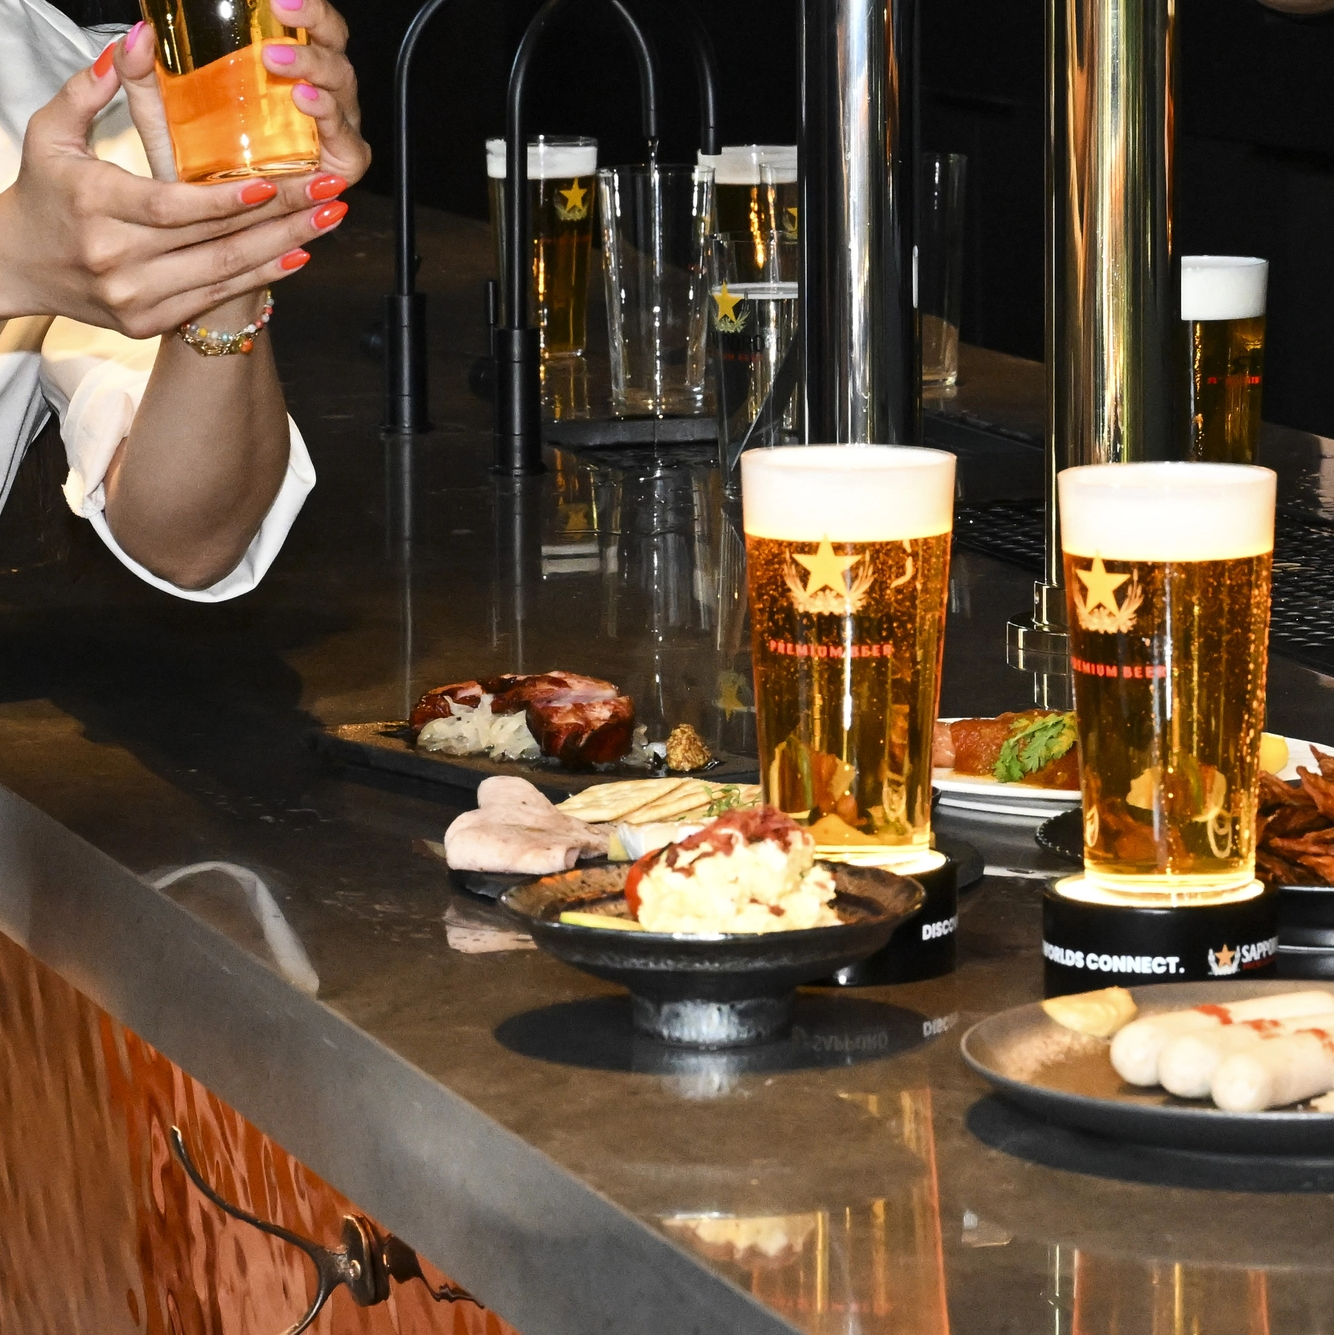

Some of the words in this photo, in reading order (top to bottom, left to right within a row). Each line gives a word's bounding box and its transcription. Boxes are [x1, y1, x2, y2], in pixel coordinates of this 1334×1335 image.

[769, 639, 843, 658] PREMIUM
[849, 644, 893, 658] BEER
[1086, 953, 1185, 974] CONNECT.
